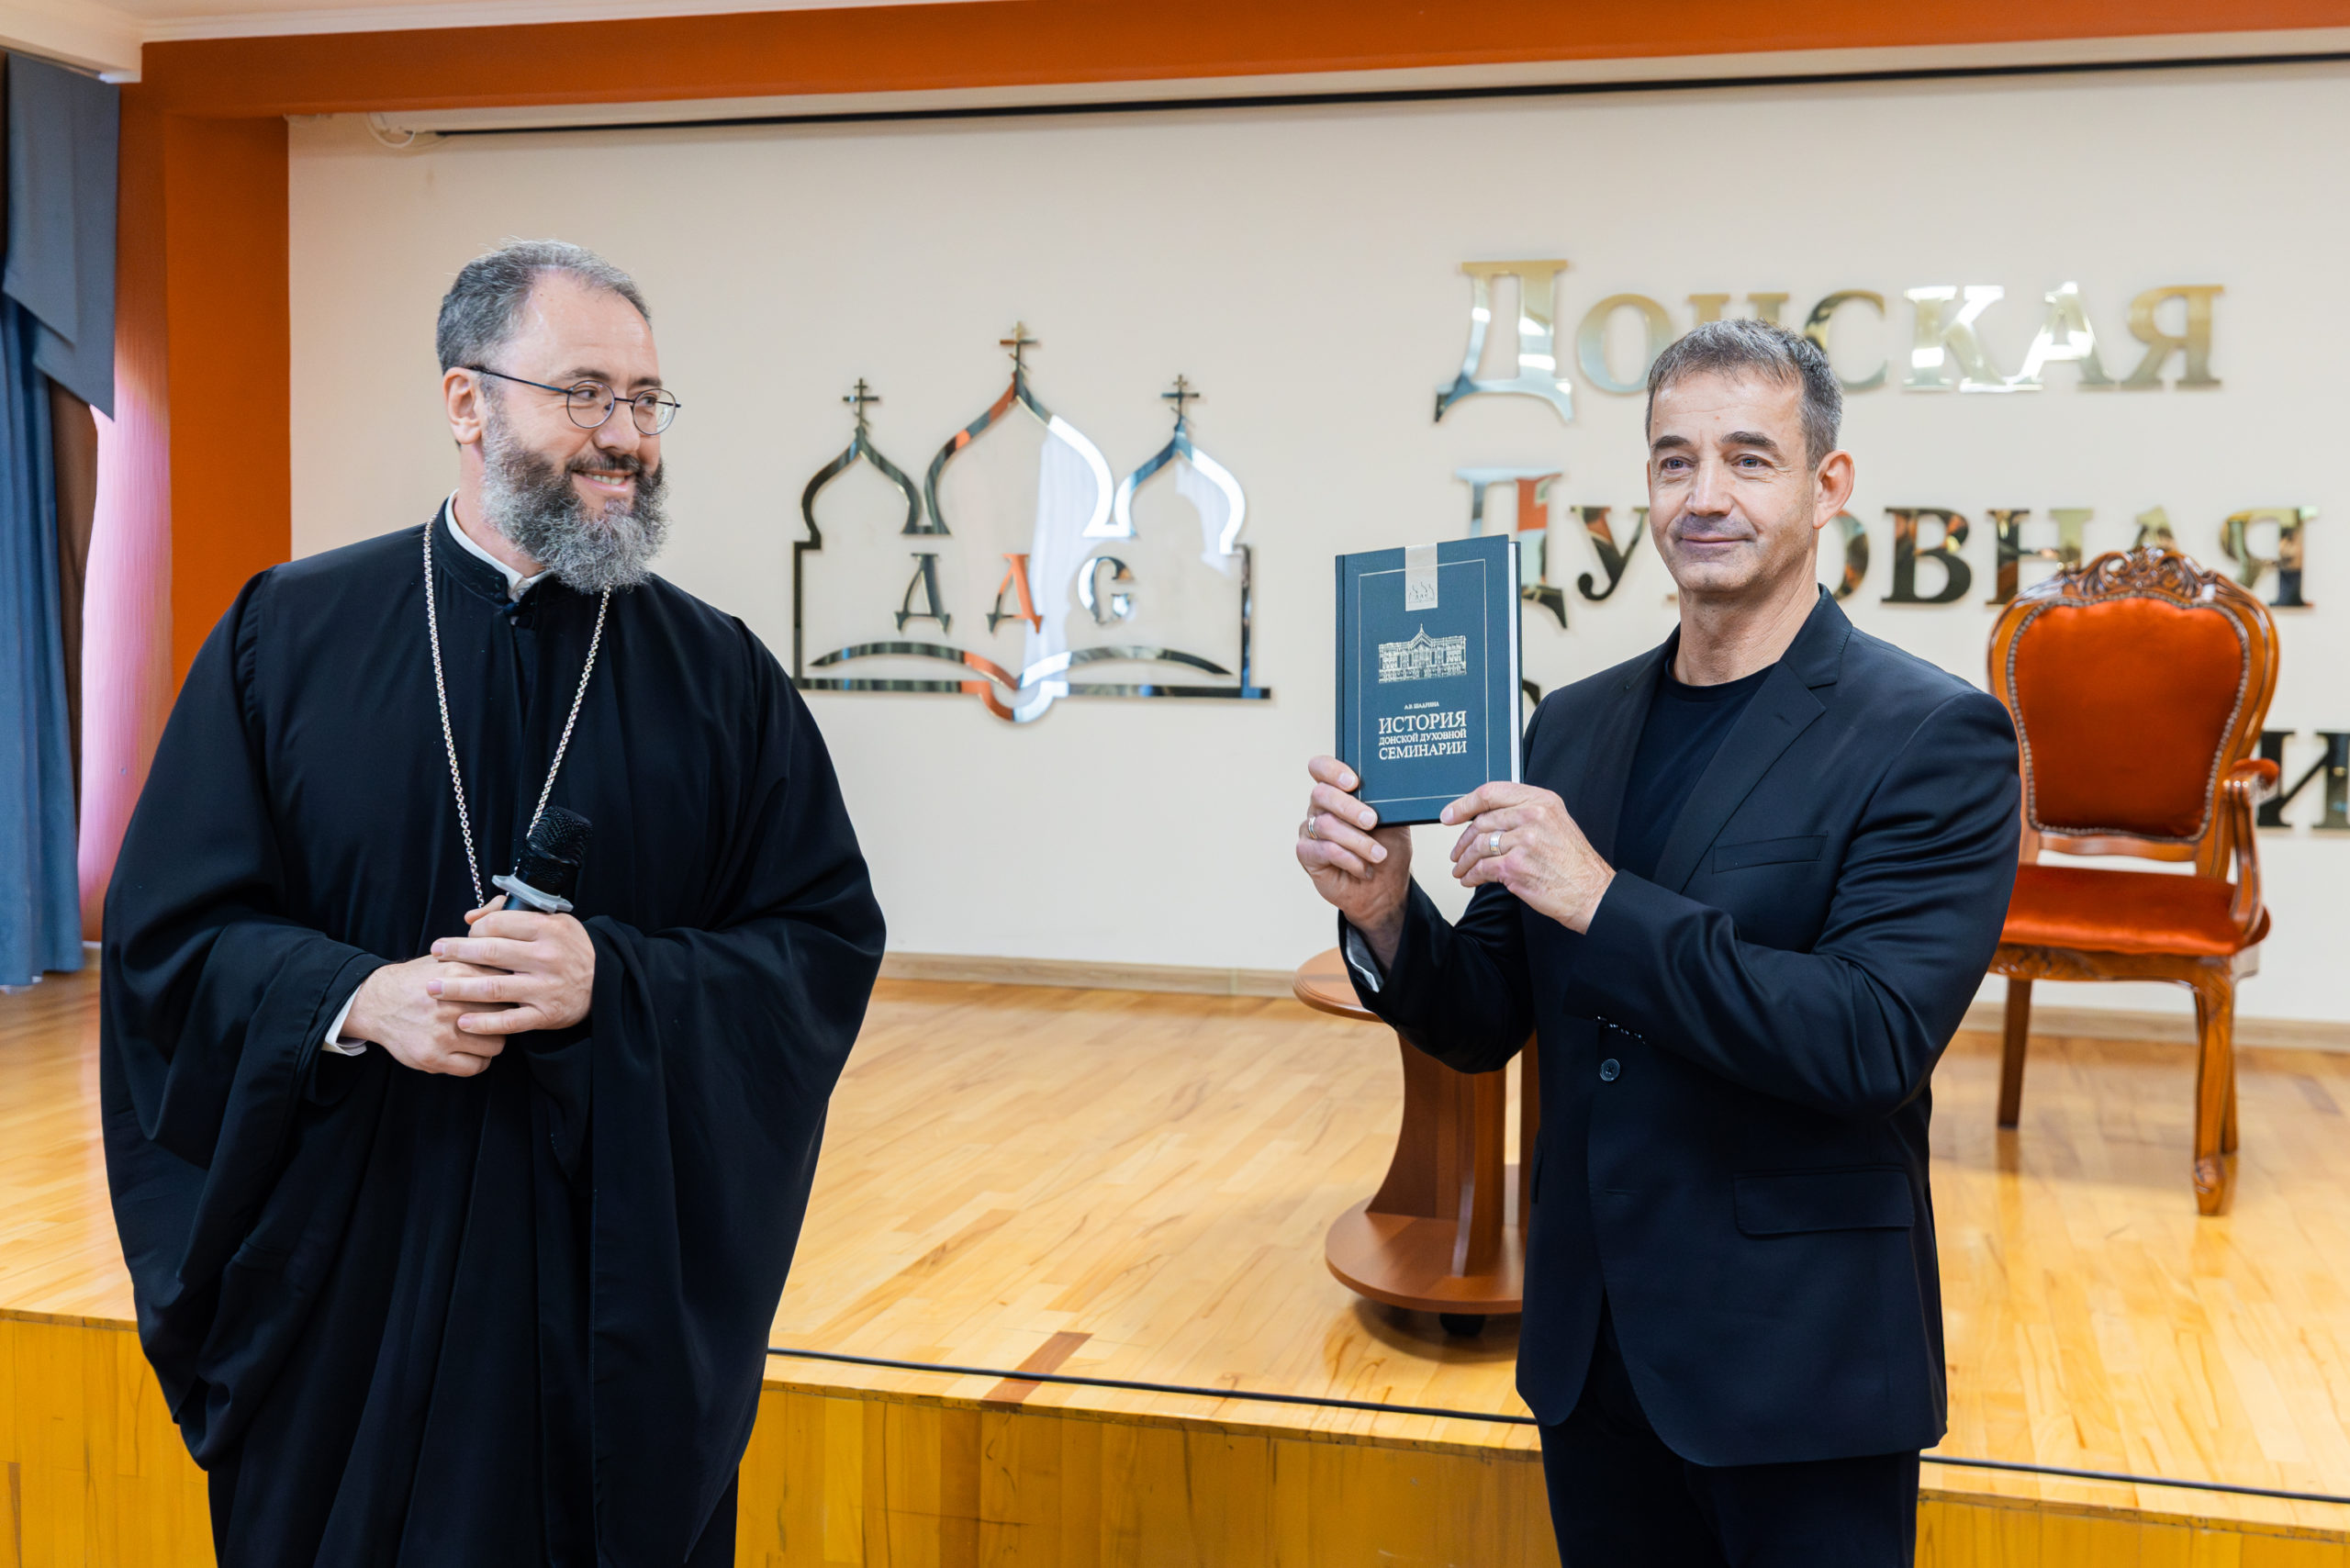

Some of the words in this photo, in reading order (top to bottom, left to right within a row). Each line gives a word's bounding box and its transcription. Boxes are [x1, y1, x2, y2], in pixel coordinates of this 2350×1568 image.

[1379, 711, 1467, 734] ИСТОРИЯ
[1379, 732, 1418, 746] ДОНСКОЙ
[1420, 728, 1467, 743] ДУХОВНОЙ
[1379, 741, 1467, 760] СЕМИНАРИИ
